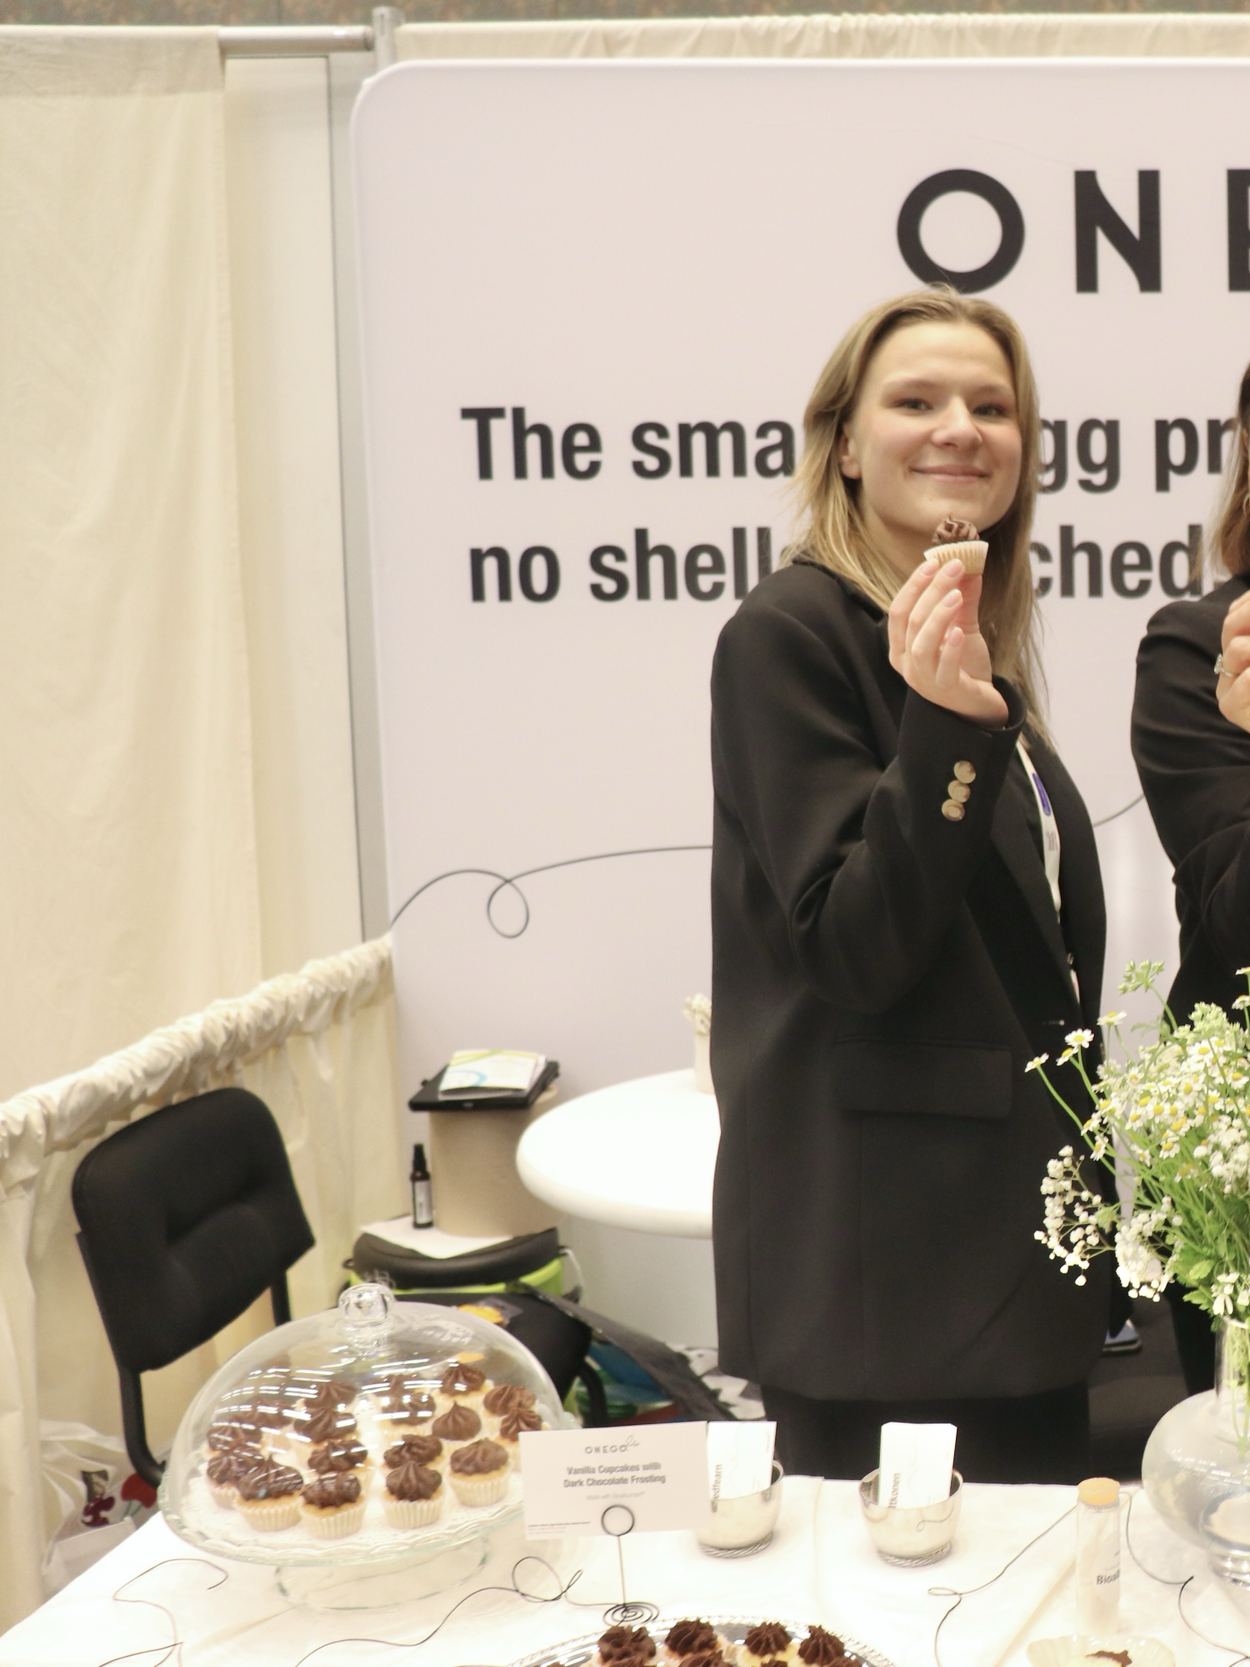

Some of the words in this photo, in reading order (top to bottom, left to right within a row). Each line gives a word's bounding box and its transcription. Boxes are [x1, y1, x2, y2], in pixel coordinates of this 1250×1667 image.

[461, 406, 602, 481] The
[631, 418, 795, 480] sma
[1039, 417, 1121, 494] gg
[469, 545, 561, 603] no
[588, 526, 777, 603] shell
[584, 1445, 628, 1455] ONEGO
[566, 1466, 596, 1476] Vanilla
[598, 1464, 640, 1476] Cupcakes
[642, 1462, 662, 1471] with
[564, 1478, 584, 1488] Dark
[586, 1476, 629, 1487] Chocolate
[630, 1474, 666, 1484] Frosting
